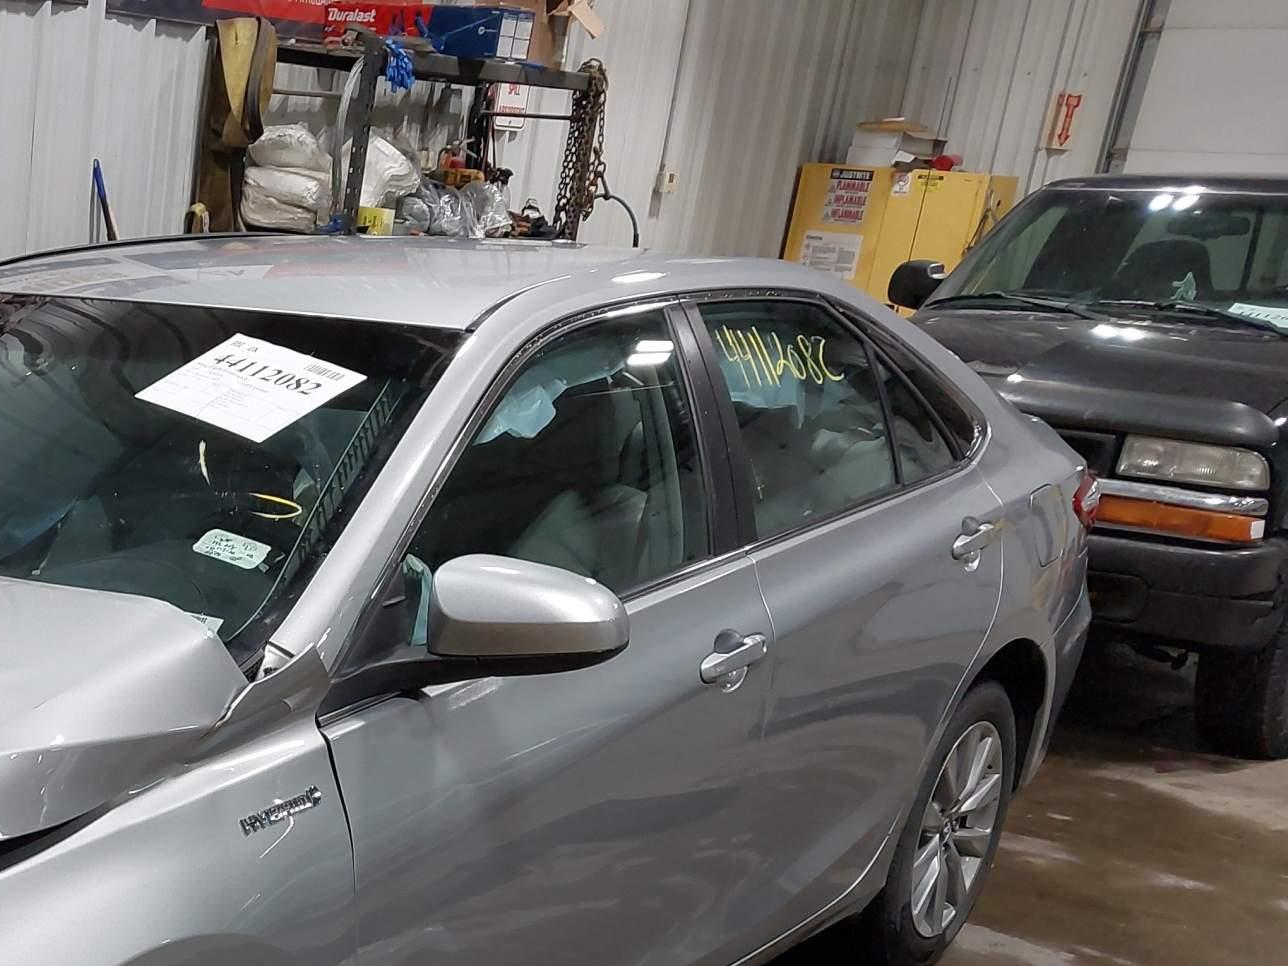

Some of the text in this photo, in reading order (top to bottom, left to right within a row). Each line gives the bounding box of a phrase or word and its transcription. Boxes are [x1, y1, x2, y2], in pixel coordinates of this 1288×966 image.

[327, 7, 376, 22] Duralast
[214, 353, 322, 395] 44112082
[715, 325, 845, 389] 44112082
